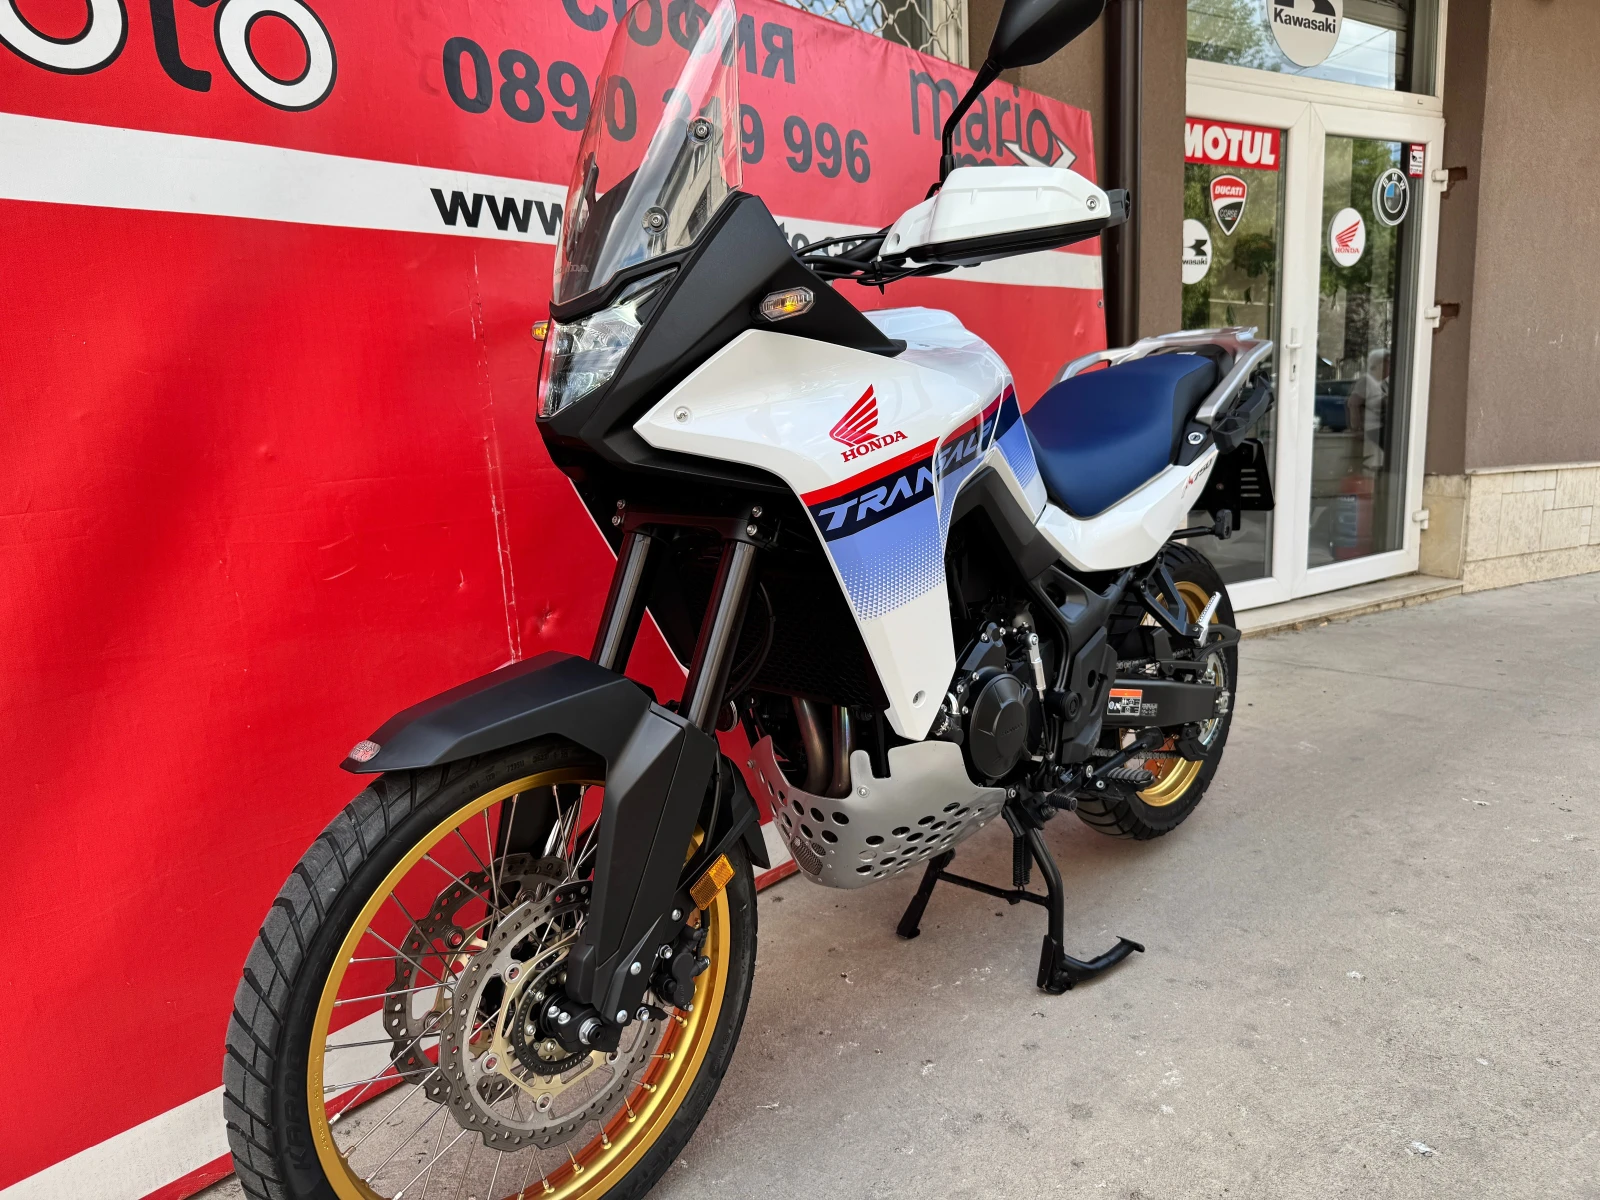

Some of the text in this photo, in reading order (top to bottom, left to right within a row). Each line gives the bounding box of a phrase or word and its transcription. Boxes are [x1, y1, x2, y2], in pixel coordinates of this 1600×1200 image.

[1273, 7, 1336, 34] Kawasaki
[443, 37, 637, 142] 0890
[783, 115, 871, 183] 996
[909, 69, 1053, 158] mario
[1185, 122, 1275, 166] MOTUL
[1214, 185, 1243, 196] DUCATI
[1383, 172, 1406, 191] BMW
[1219, 208, 1238, 219] CORSE
[1334, 246, 1360, 255] HONDA
[840, 430, 908, 463] HONDA
